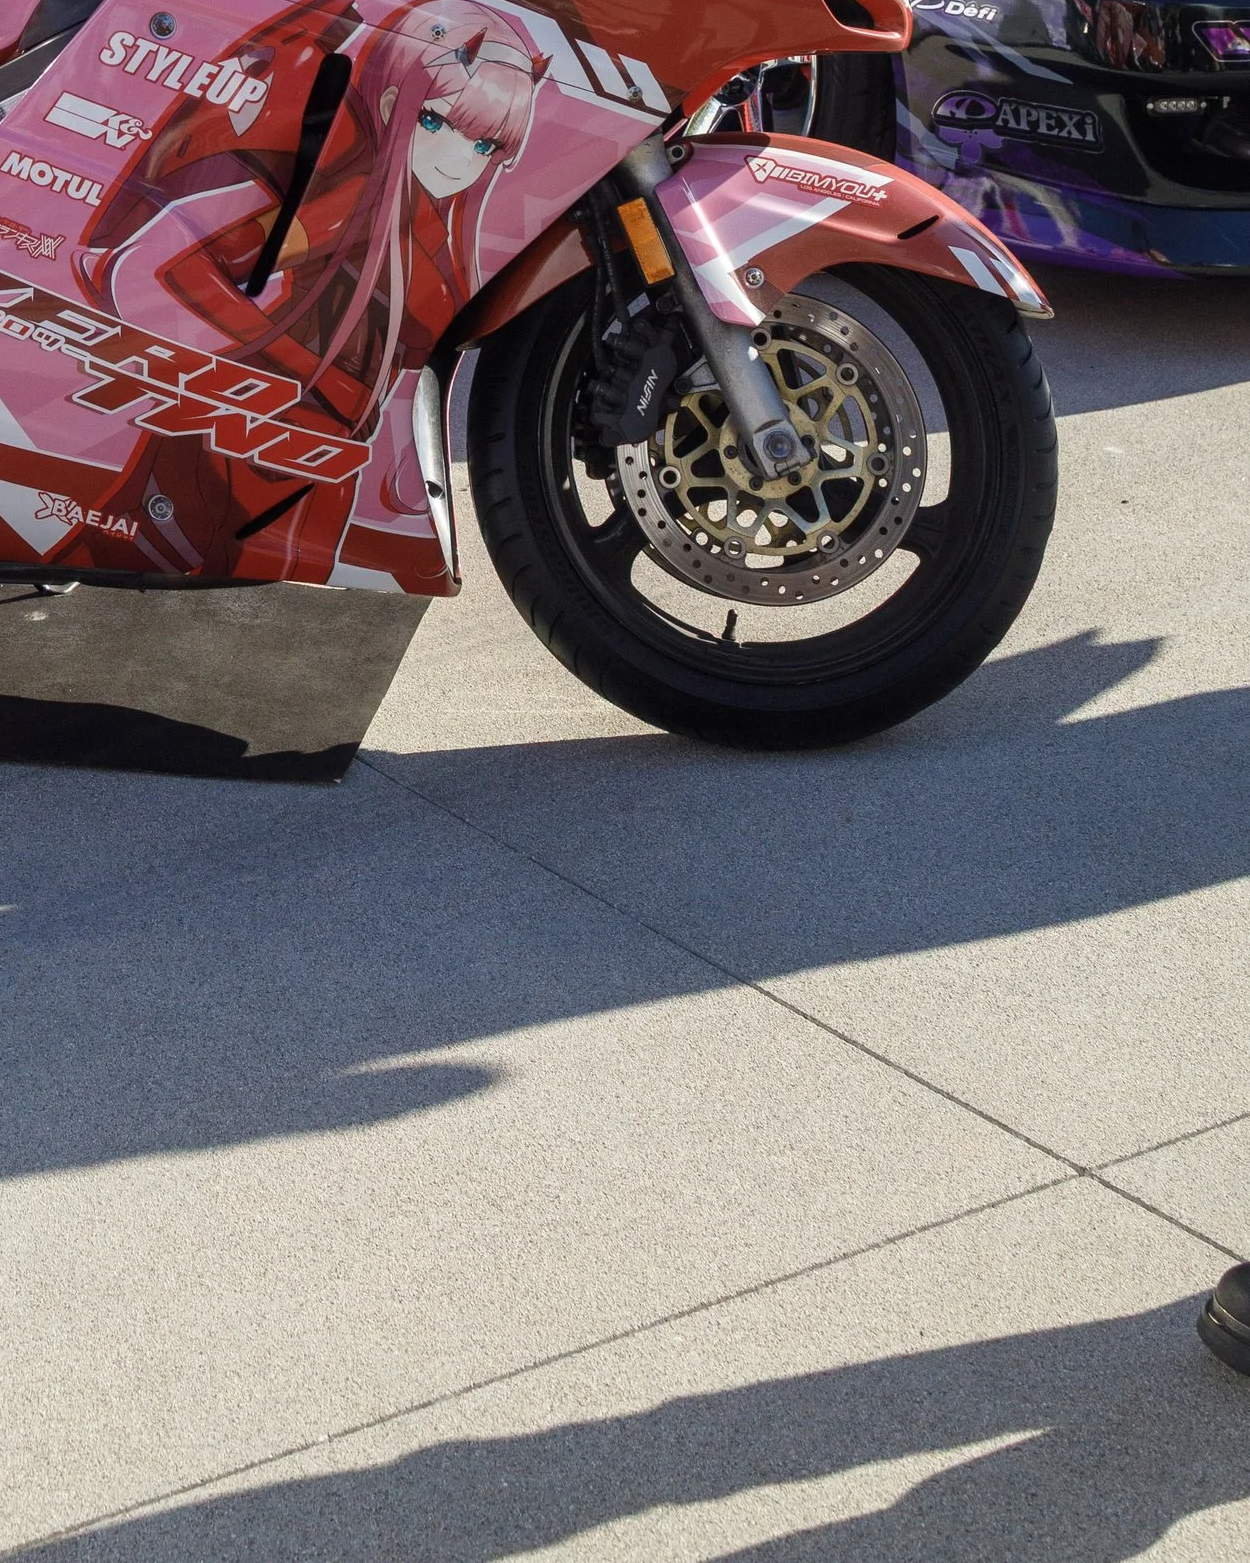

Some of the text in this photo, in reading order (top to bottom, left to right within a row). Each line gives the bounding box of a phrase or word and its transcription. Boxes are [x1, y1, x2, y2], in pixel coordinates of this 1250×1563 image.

[100, 31, 268, 113] STYLEUP
[1, 151, 103, 206] MOTUL
[71, 356, 374, 484] TWO
[52, 498, 139, 536] BAEJAI
